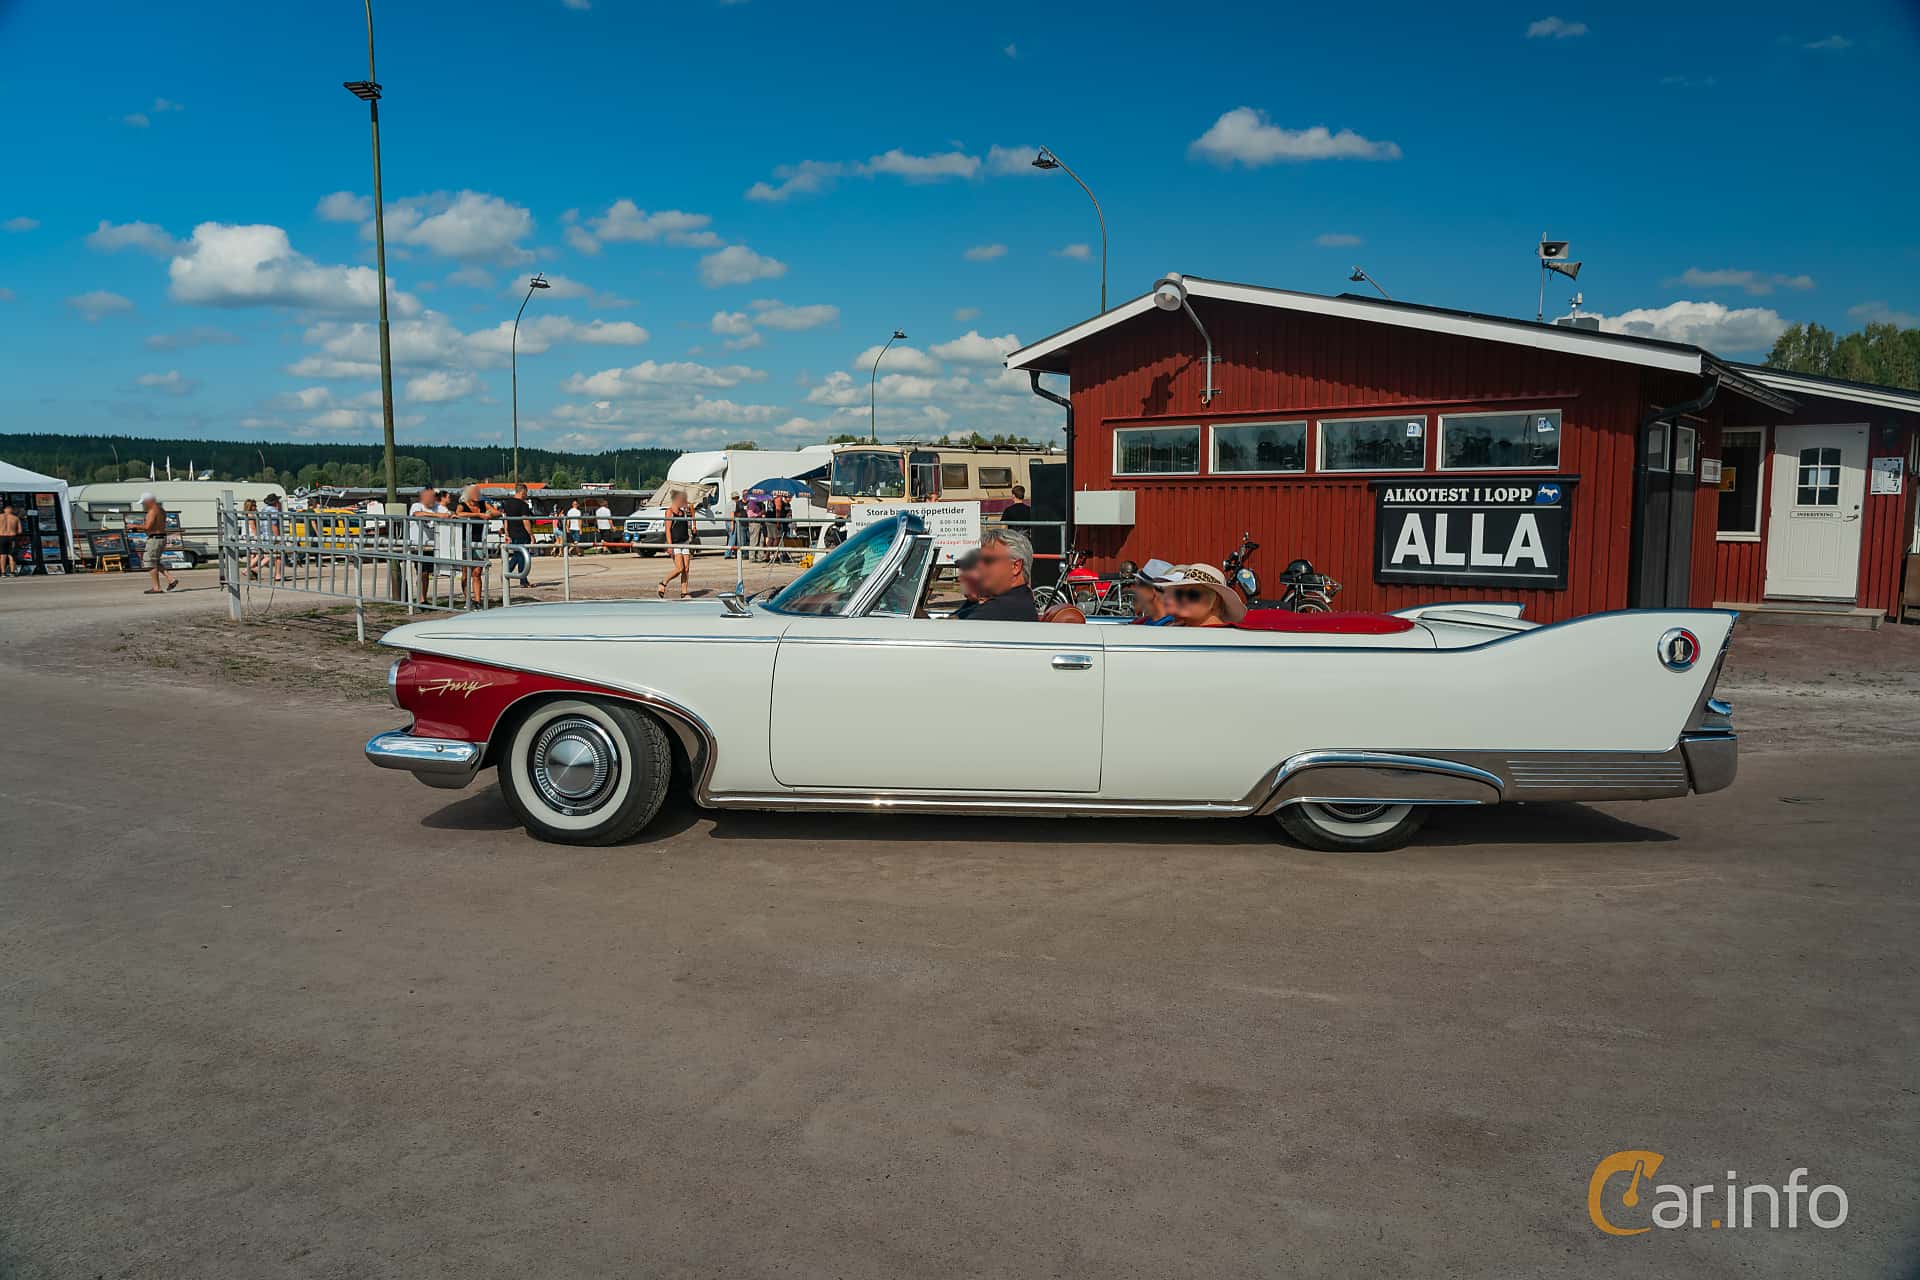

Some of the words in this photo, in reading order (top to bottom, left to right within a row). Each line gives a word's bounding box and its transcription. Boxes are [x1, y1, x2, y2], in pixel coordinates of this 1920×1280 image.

[1383, 488, 1469, 502] ALKOTEST
[1473, 488, 1481, 502] I
[1485, 488, 1533, 502] LOPP
[866, 508, 889, 517] Stora
[920, 507, 965, 518] öppettider
[1390, 513, 1549, 568] ALLA
[418, 678, 495, 699] Fury
